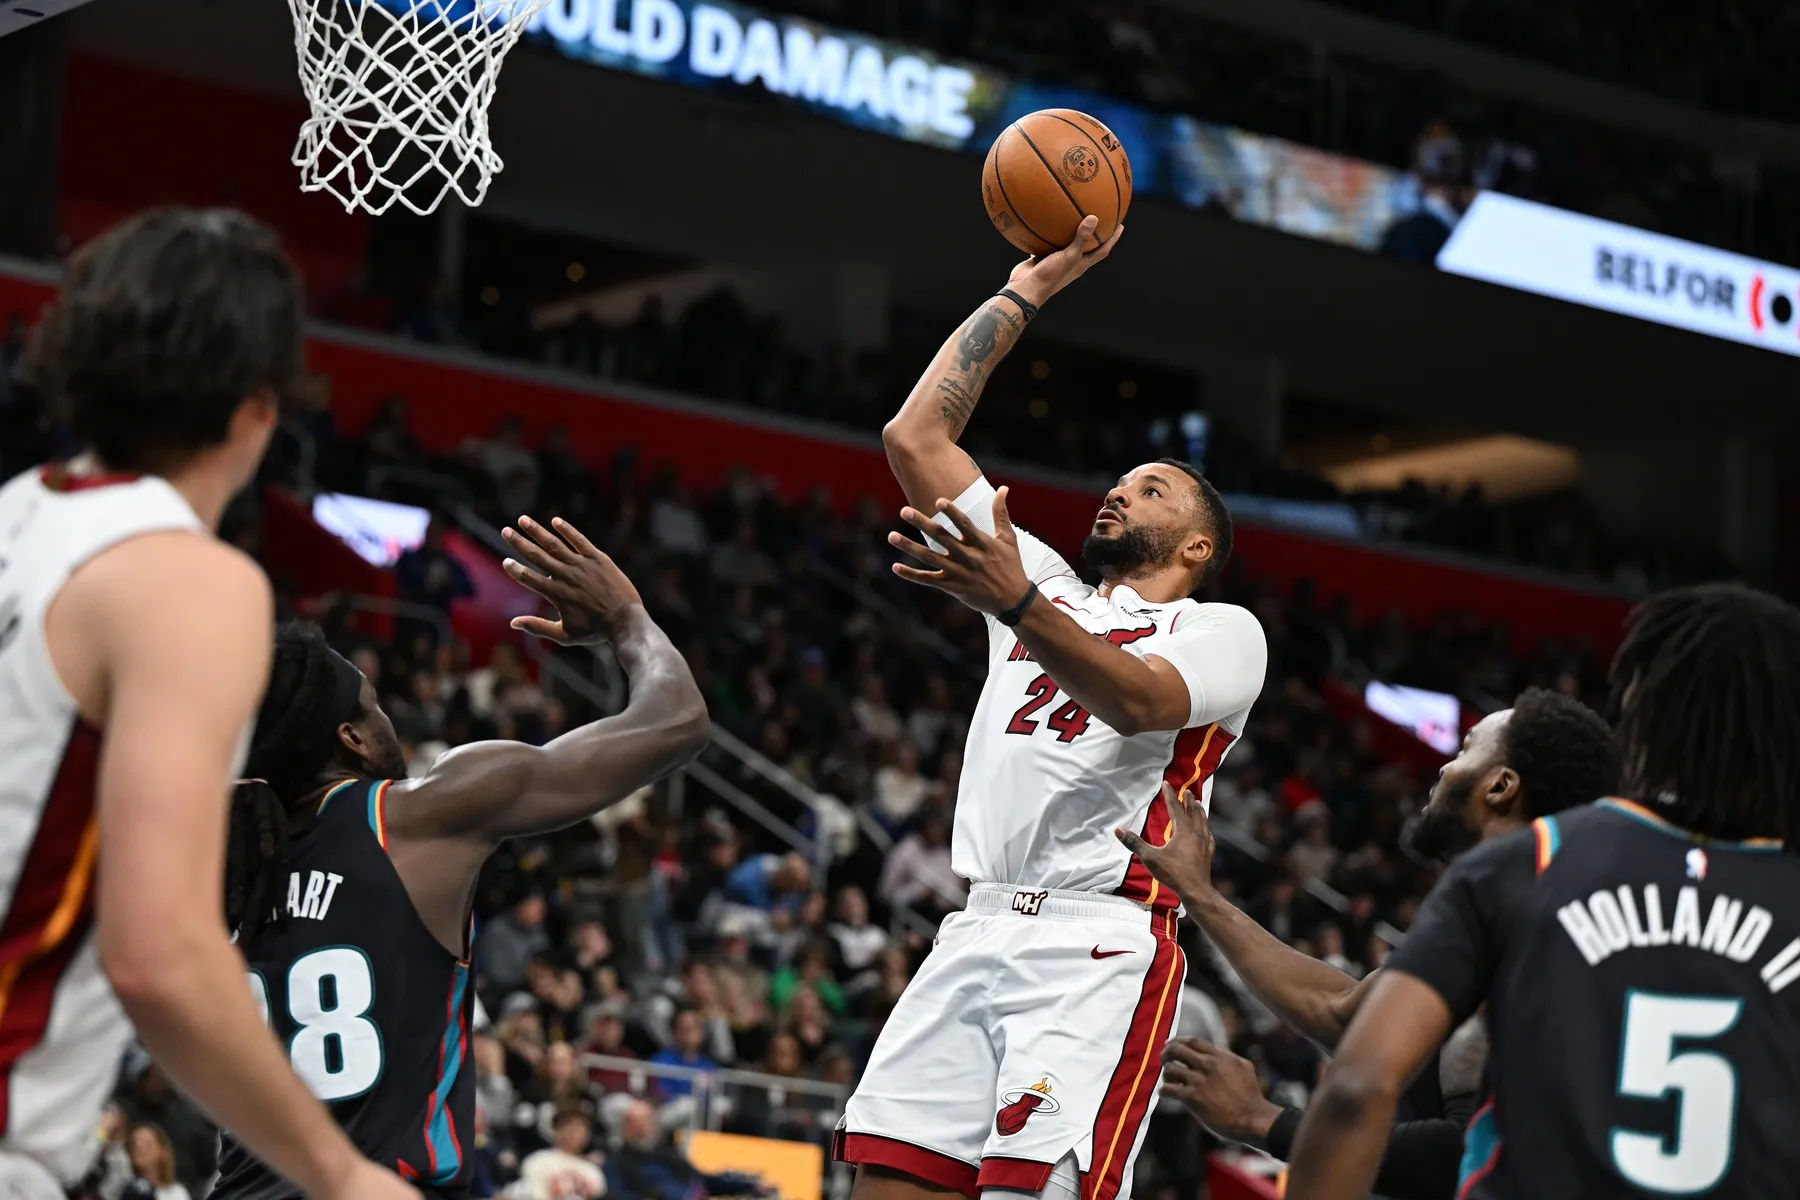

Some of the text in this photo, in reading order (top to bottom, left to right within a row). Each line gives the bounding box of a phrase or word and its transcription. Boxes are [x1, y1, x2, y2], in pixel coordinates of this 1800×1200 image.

[690, 10, 976, 139] DAMAGE
[1595, 247, 1738, 312] BELFOR
[1005, 672, 1092, 743] 24
[1556, 882, 1773, 967] HOLLAND
[1608, 988, 1745, 1196] 5
